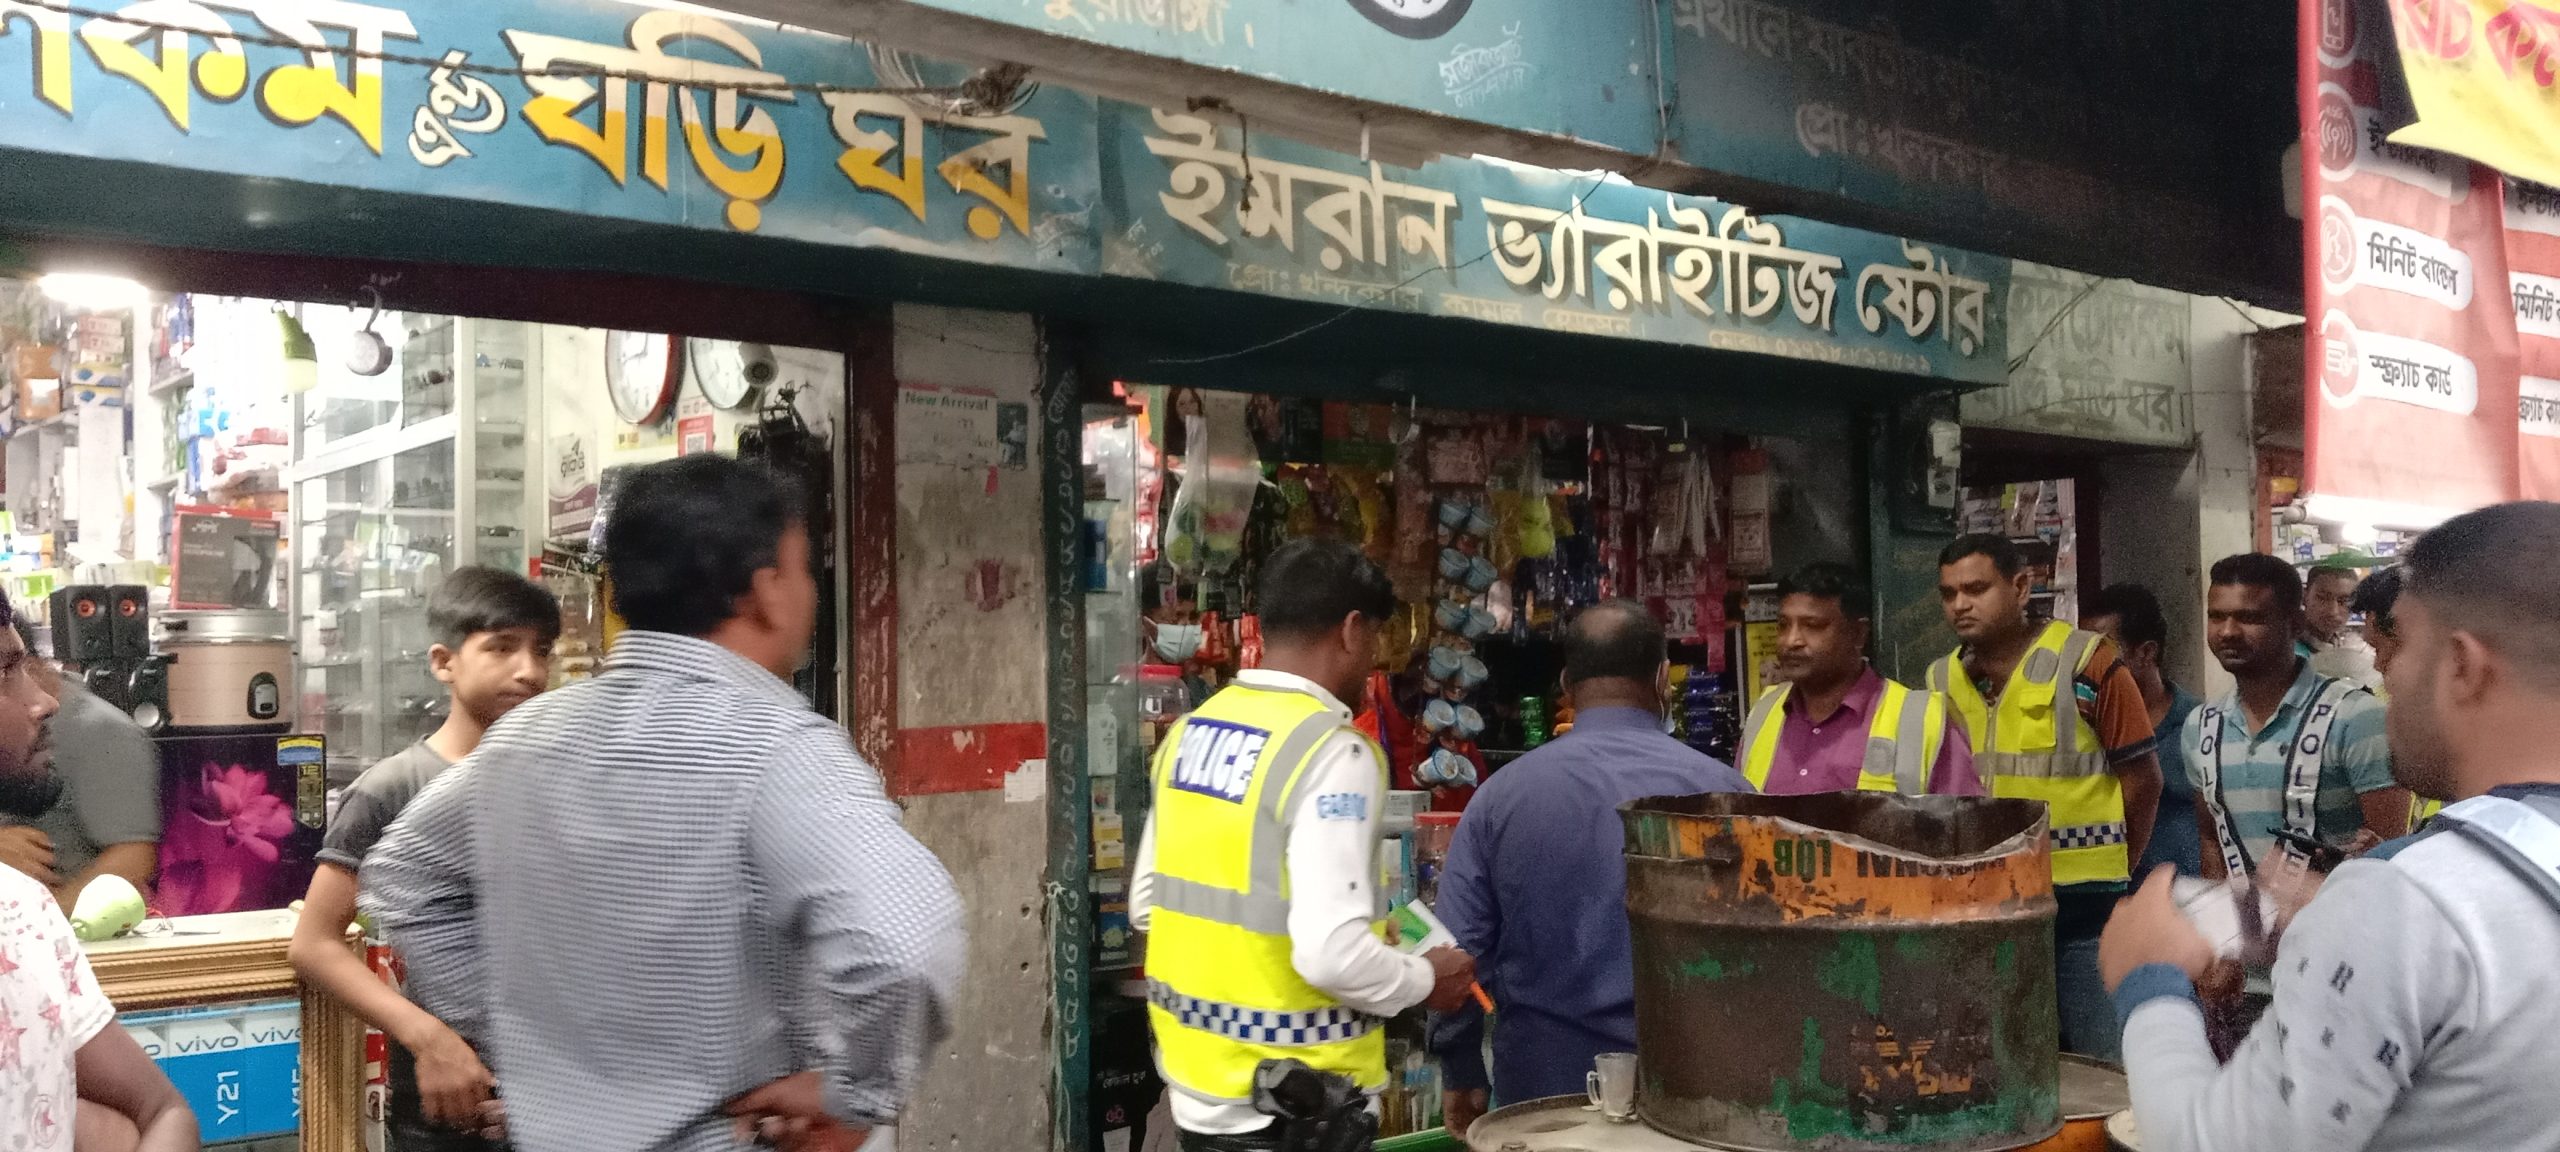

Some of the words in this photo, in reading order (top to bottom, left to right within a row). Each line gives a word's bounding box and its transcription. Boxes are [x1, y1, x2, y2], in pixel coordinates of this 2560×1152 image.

[500, 8, 795, 233] ঘড়ি
[818, 82, 1047, 240] ঘর
[1143, 108, 1457, 272] ইমরান
[1481, 192, 1843, 331] ভ্যারাইটিজ
[1856, 237, 1990, 357] ষ্টোর
[2367, 232, 2417, 278] মিনিট
[2513, 283, 2553, 322] মিনিট
[2423, 363, 2453, 395] কার্ড
[905, 391, 936, 406] New
[941, 396, 988, 411] Arrival
[175, 1035, 239, 1053] vivo
[216, 1070, 240, 1126] Y21
